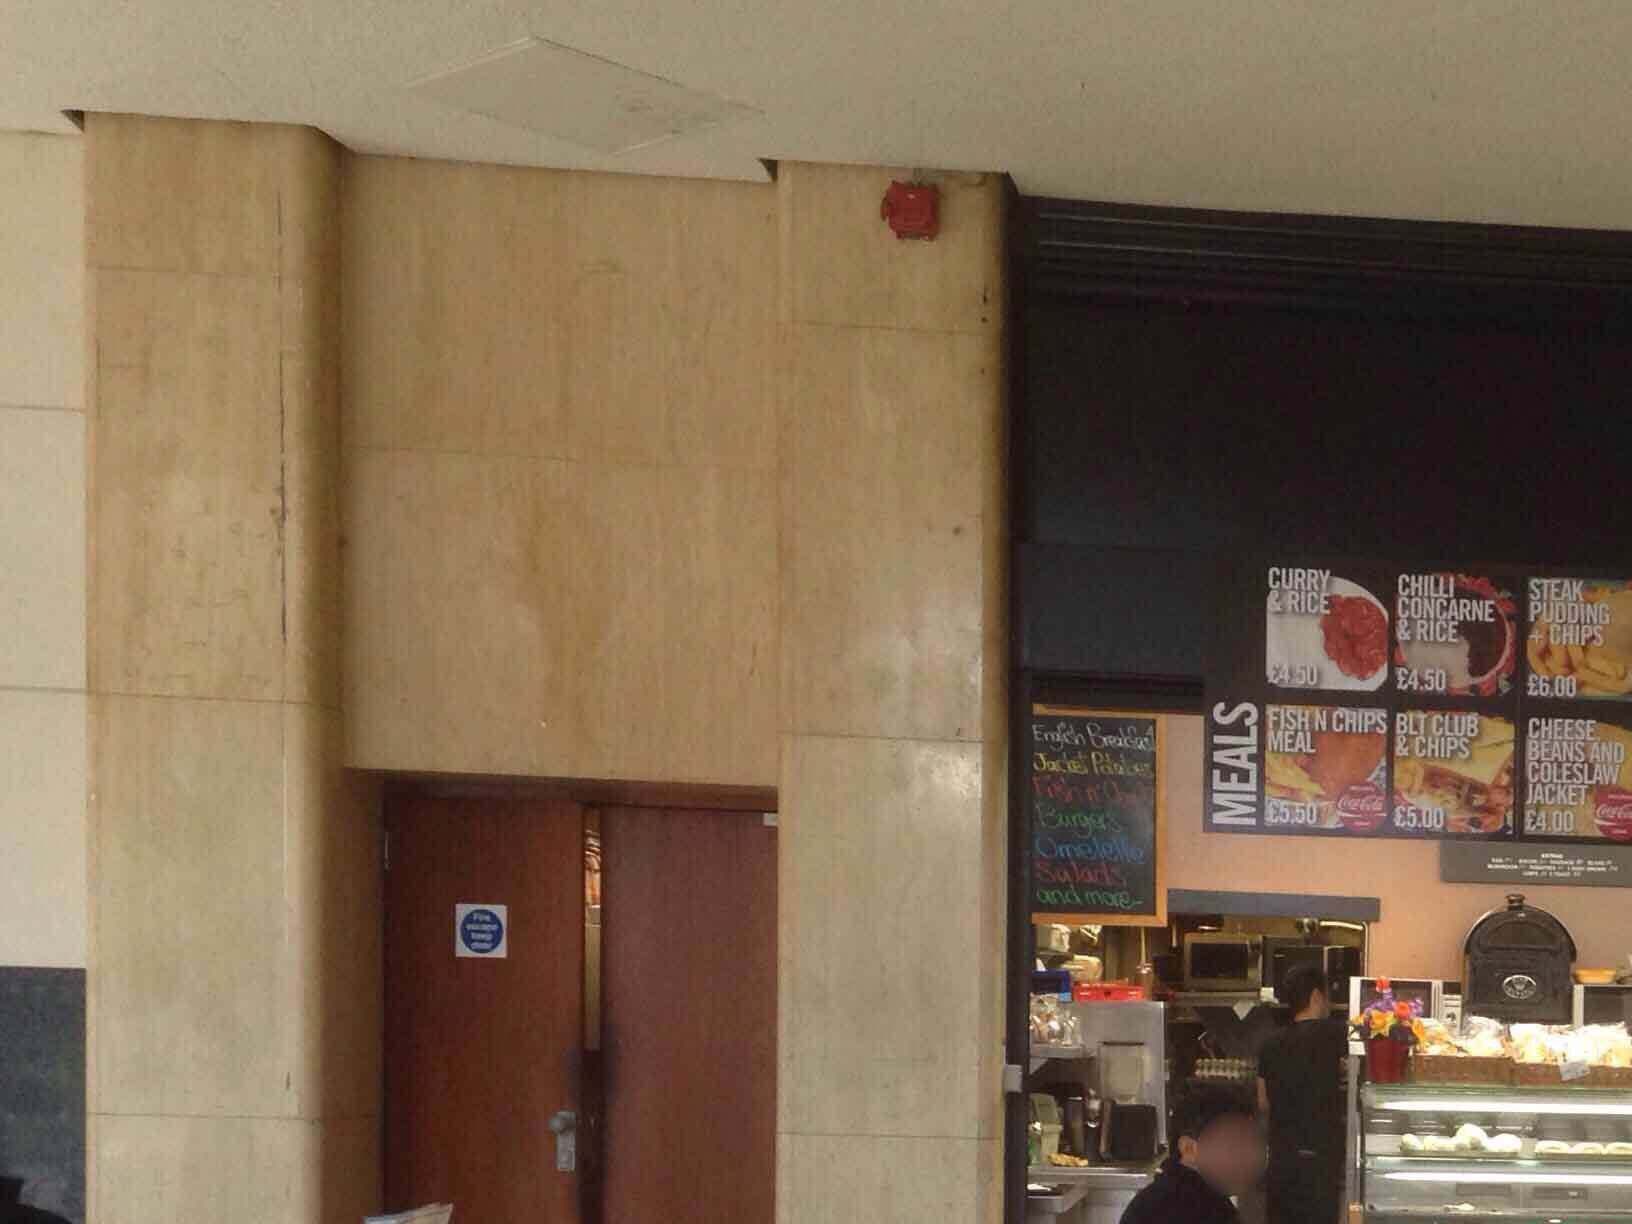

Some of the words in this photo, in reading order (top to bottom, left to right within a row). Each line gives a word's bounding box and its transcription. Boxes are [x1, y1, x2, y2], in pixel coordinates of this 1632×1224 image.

[1268, 567, 1331, 591] CURRY
[1398, 574, 1455, 598] CHILLI
[1528, 578, 1584, 601] STEAK
[1268, 591, 1283, 613] &
[1289, 592, 1331, 615] RICE
[1398, 598, 1495, 622] CONCARNE
[1528, 601, 1610, 624] PUDDING
[1398, 621, 1412, 641] &
[1417, 621, 1458, 642] RICE
[1528, 629, 1543, 644] +
[1550, 625, 1604, 646] CHIPS
[1267, 665, 1318, 685] £4.50
[1397, 668, 1446, 690] £4.50
[1528, 675, 1577, 697] £6.00
[1267, 709, 1310, 731] FISH
[1314, 711, 1327, 732] N
[1332, 710, 1388, 735] CHIPS
[1395, 713, 1427, 735] BLT
[1432, 714, 1479, 737] CLUB
[1528, 718, 1597, 741] CHEESE
[1268, 731, 1317, 753] MEAL
[1395, 737, 1409, 757] &
[1415, 738, 1470, 759] CHIPS
[1527, 740, 1586, 762] BEANS
[1590, 742, 1625, 764] AND
[1212, 702, 1259, 827] MEALS
[1528, 762, 1619, 785] COLESLAW
[1526, 784, 1588, 806] JACKET
[1266, 801, 1317, 824] £5.50
[1394, 807, 1444, 829] £5.00
[1525, 809, 1574, 832] £4.00
